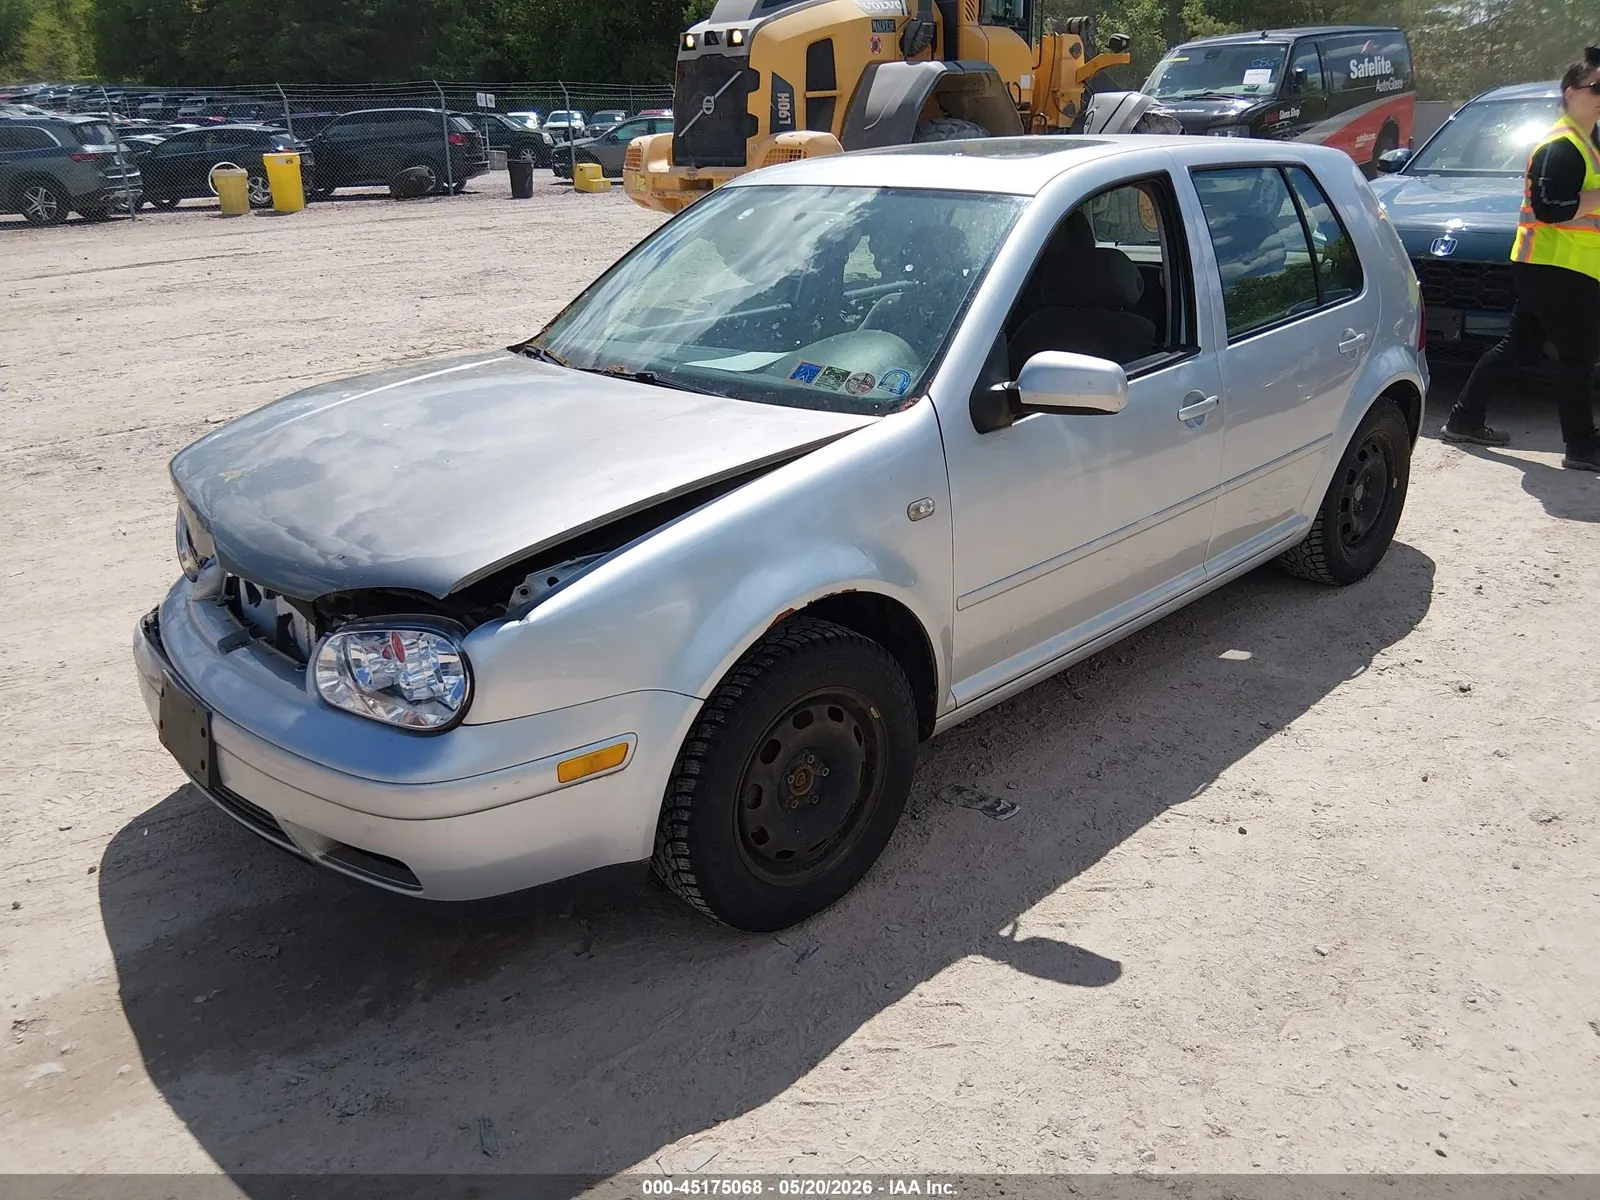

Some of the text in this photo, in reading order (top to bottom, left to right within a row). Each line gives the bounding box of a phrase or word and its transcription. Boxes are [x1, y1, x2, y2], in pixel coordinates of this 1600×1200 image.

[1349, 55, 1392, 79] Safelite
[1375, 76, 1404, 92] AutoGlass
[777, 92, 791, 125] L90H
